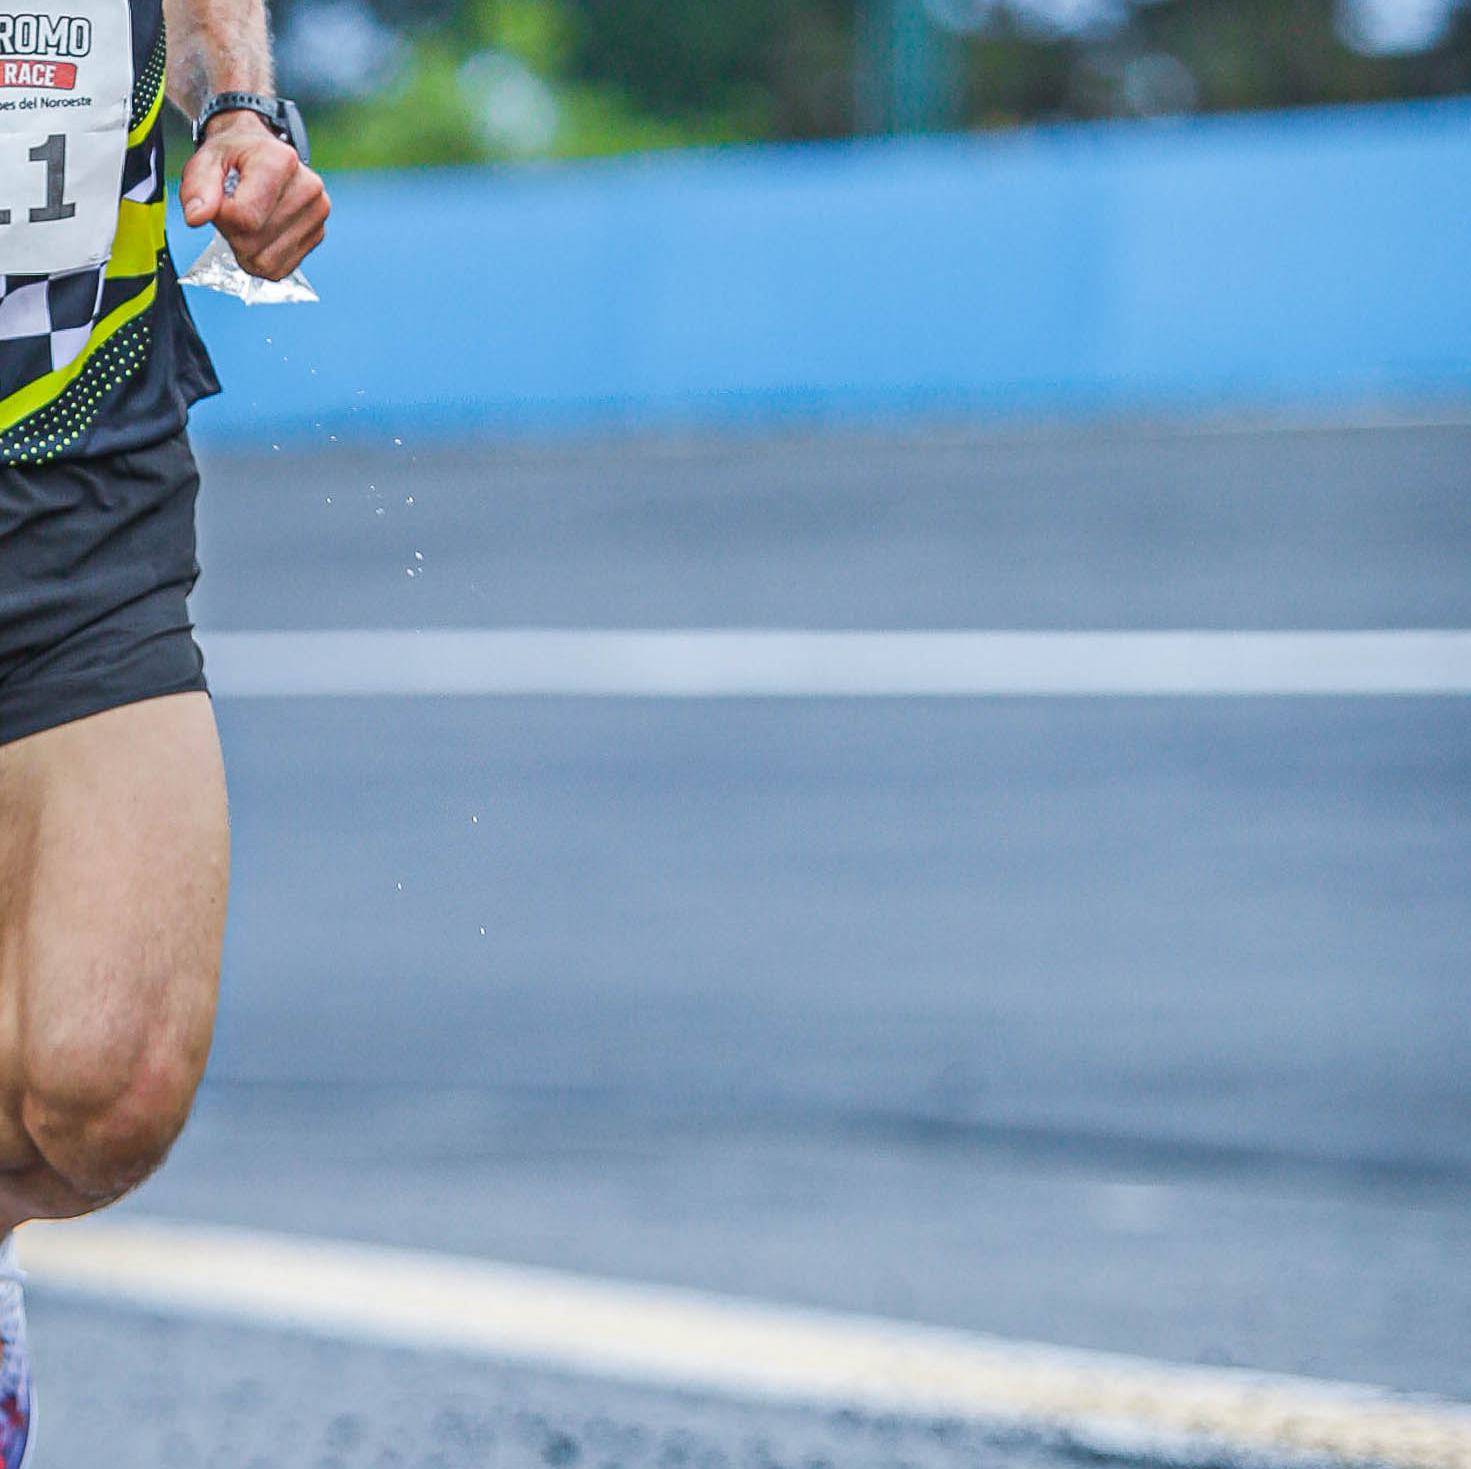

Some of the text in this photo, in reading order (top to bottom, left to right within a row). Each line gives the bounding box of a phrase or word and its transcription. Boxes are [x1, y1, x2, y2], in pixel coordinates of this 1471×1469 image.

[4, 62, 57, 86] RACE
[18, 96, 38, 110] del
[40, 96, 93, 108] Noroeste
